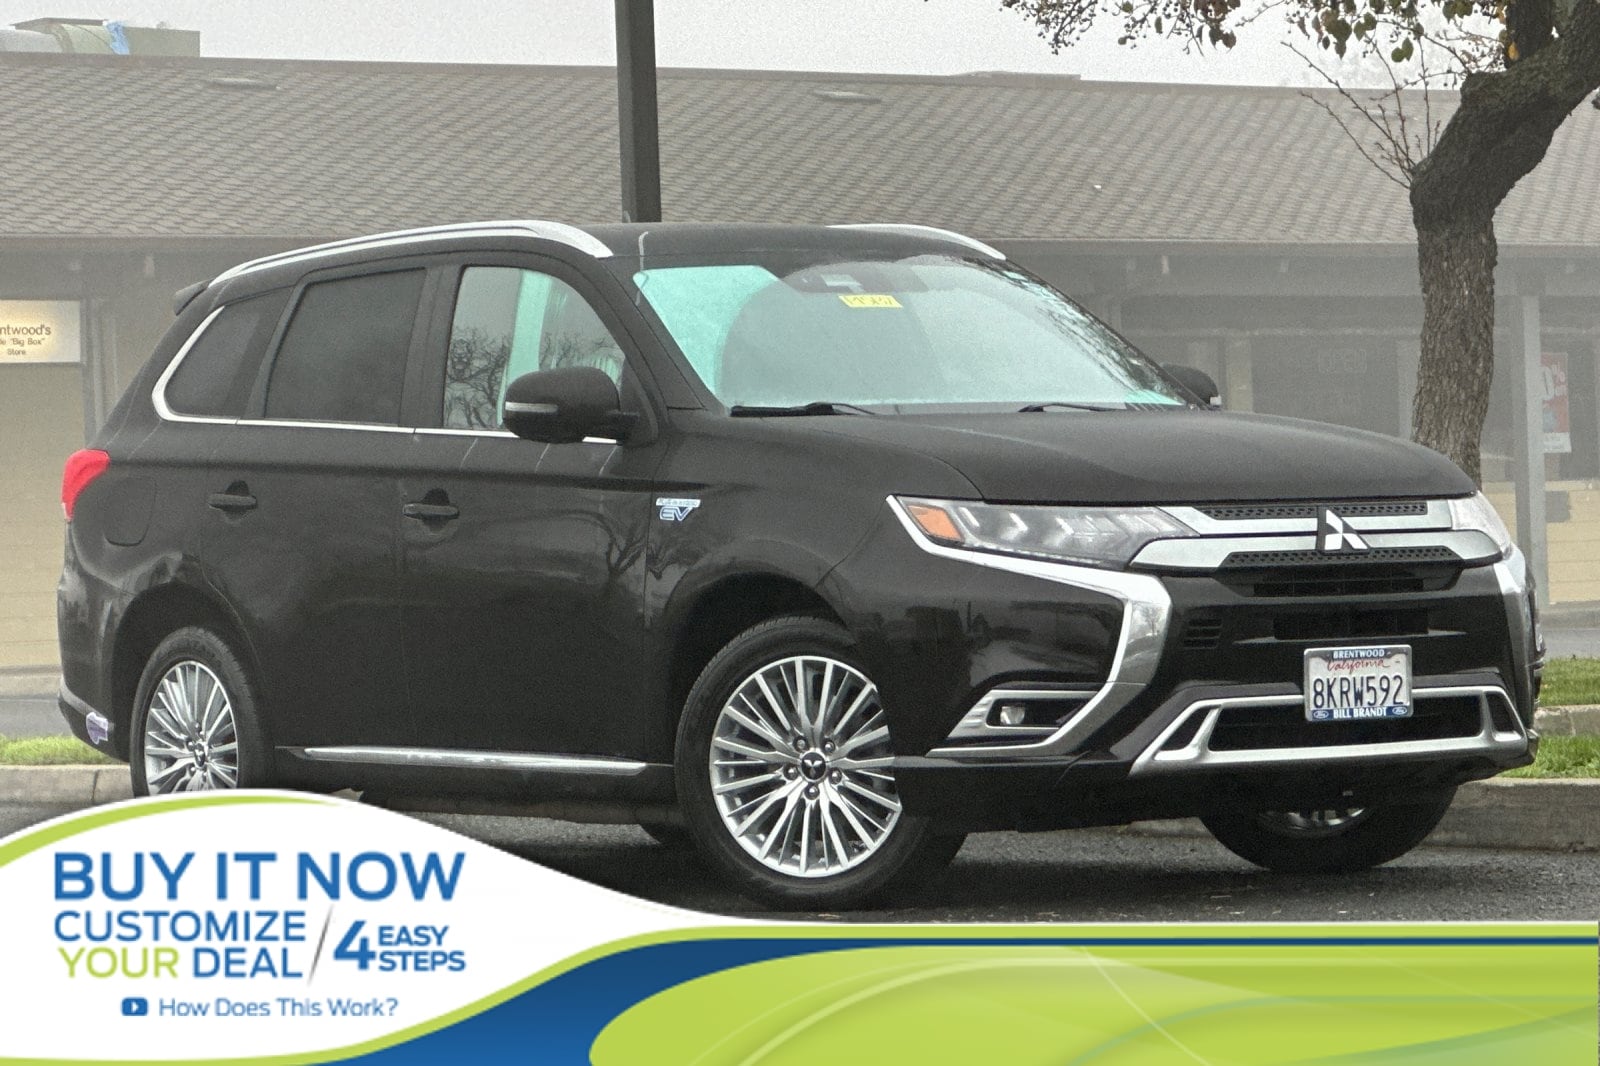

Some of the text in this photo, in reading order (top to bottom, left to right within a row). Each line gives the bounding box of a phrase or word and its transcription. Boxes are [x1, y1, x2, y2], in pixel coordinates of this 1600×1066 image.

[659, 505, 693, 521] EV
[1333, 649, 1385, 659] BRENTWOOD
[1327, 659, 1391, 674] California
[1313, 674, 1404, 708] 8KRW592
[1333, 706, 1388, 719] BILL BRANDT
